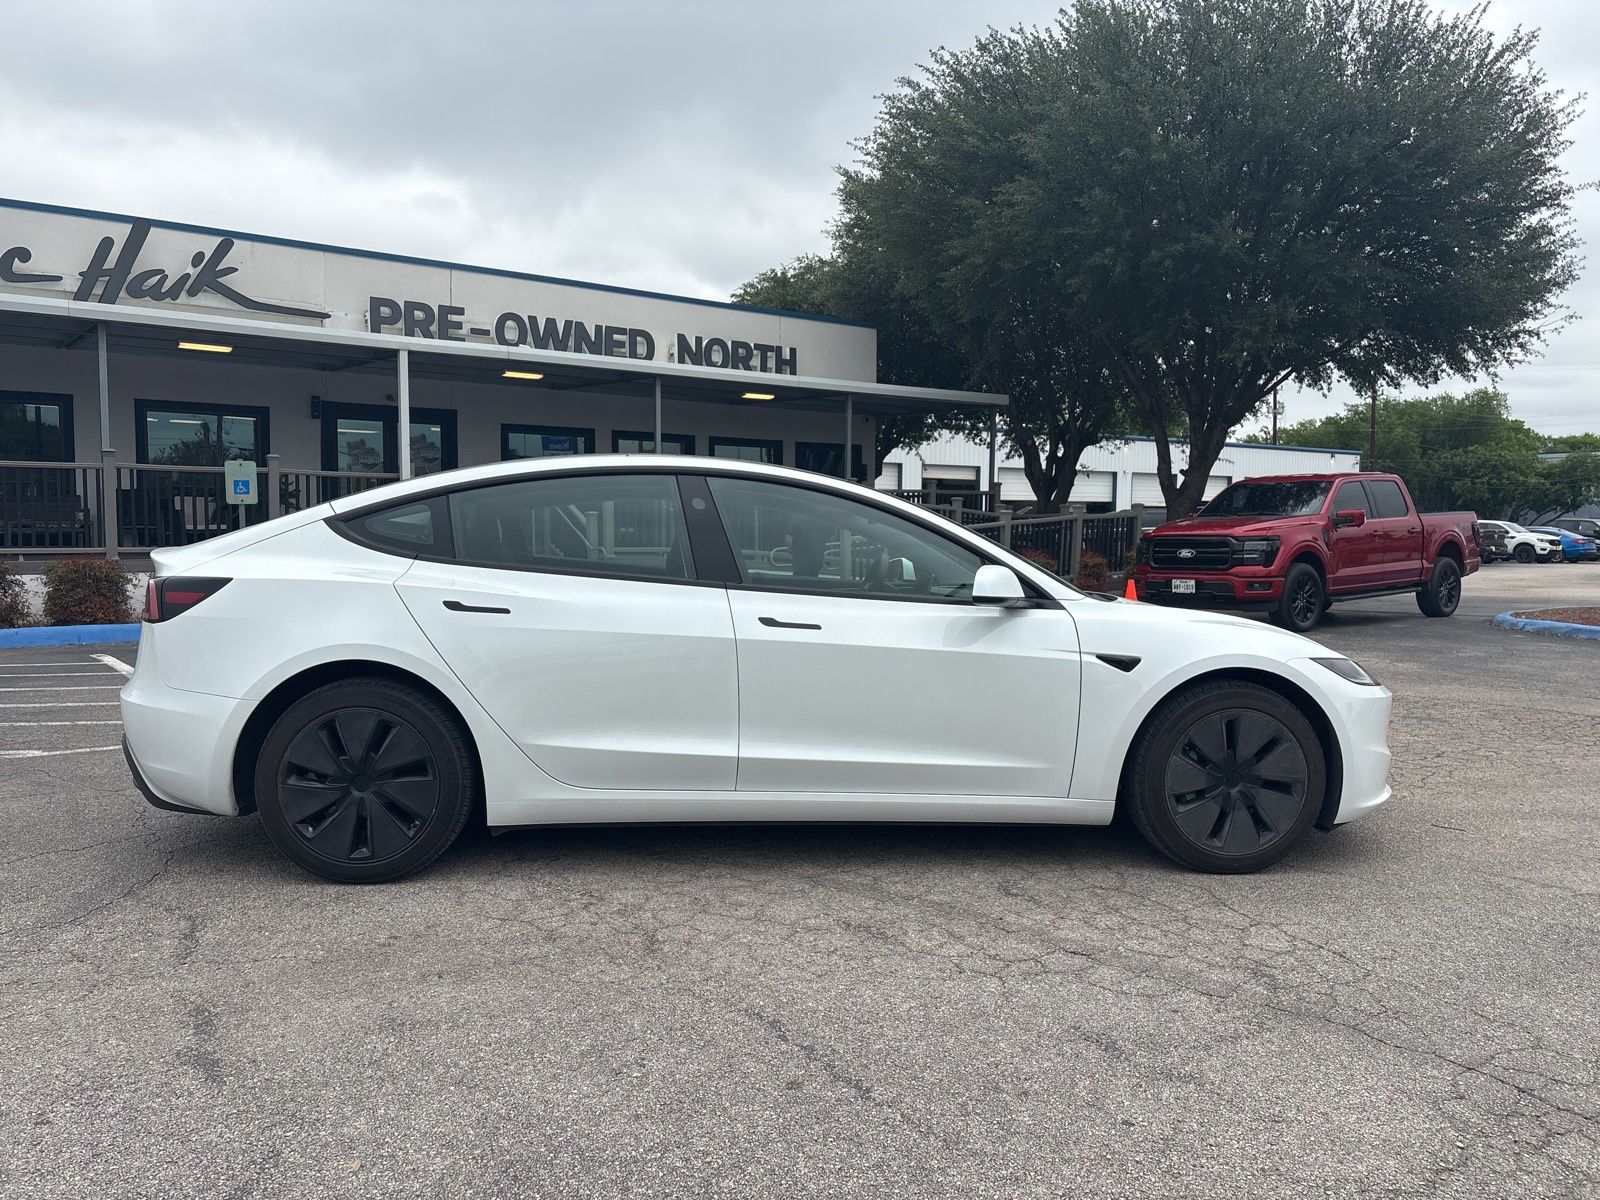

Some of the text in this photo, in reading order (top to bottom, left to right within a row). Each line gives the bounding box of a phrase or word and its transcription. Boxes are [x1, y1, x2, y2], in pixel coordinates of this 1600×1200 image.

[73, 218, 331, 319] Haik
[368, 296, 797, 376] PRE-OWNED NORTH
